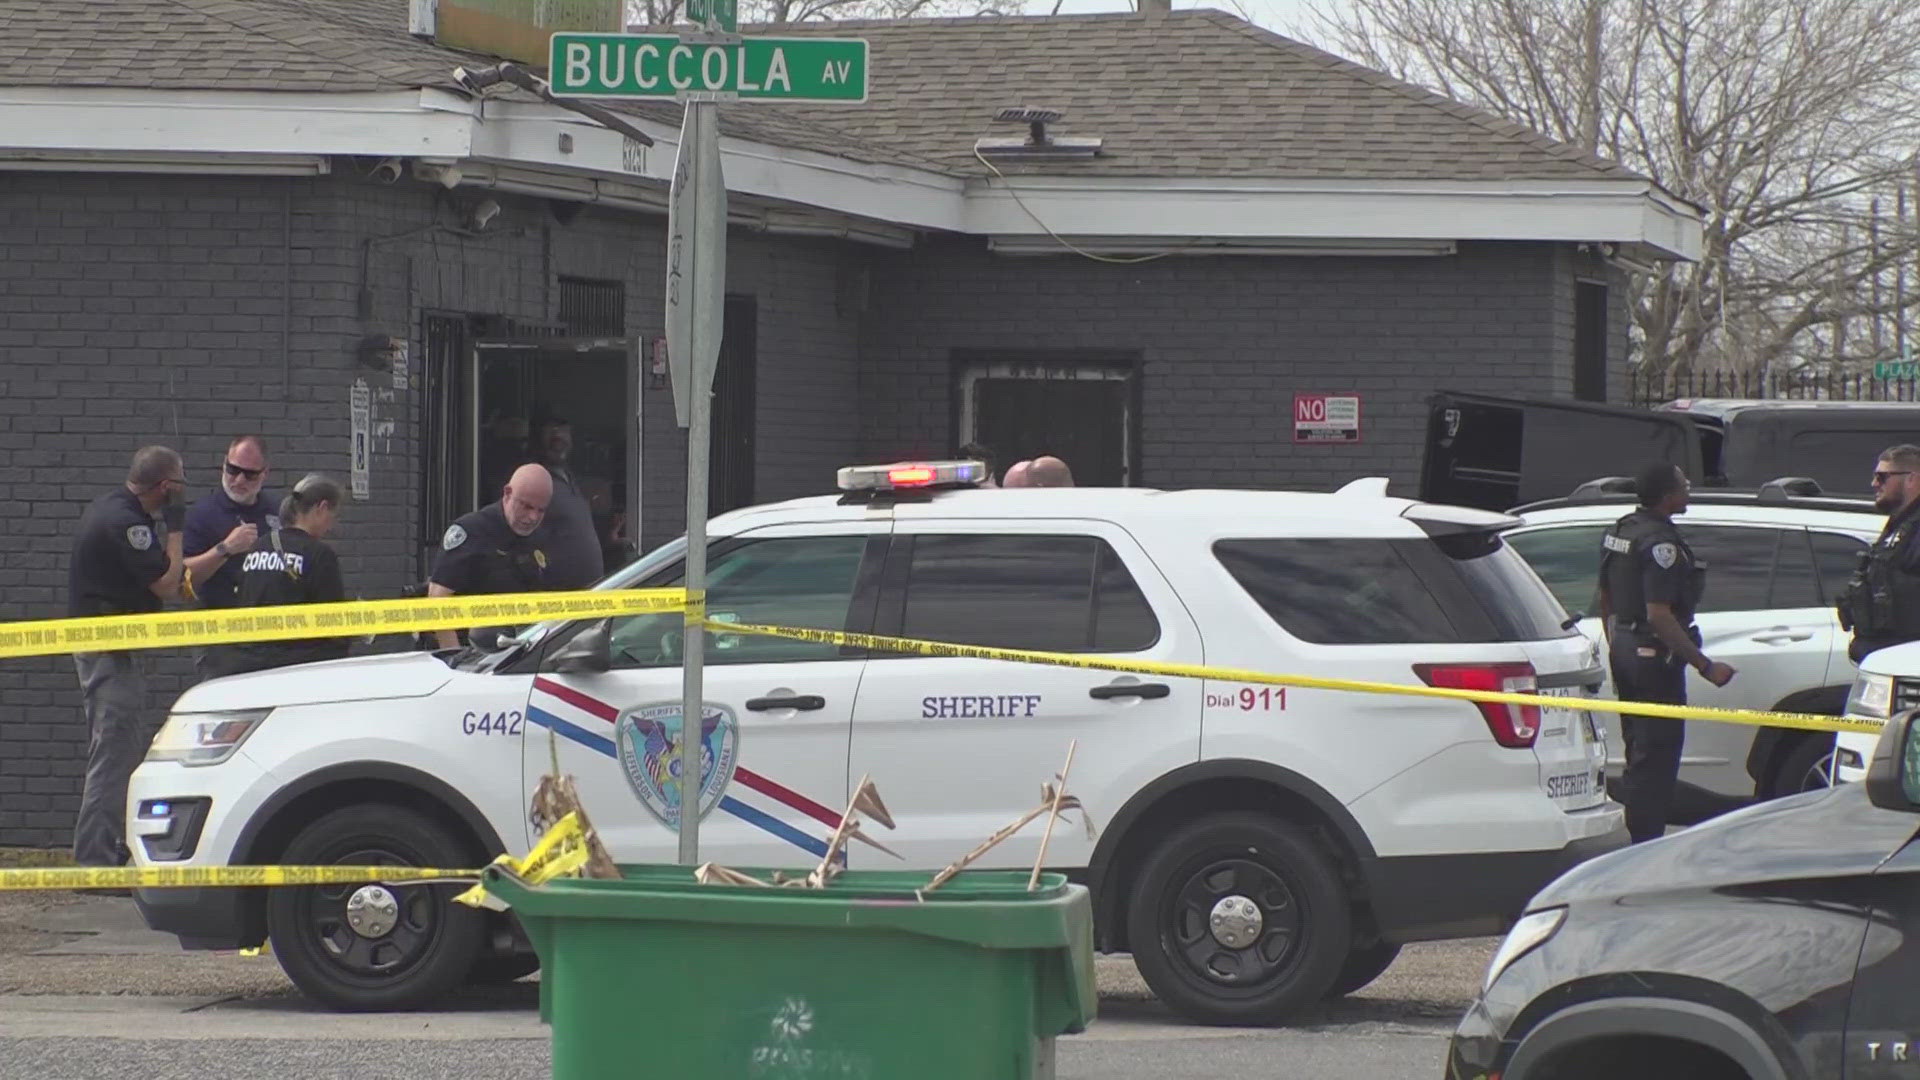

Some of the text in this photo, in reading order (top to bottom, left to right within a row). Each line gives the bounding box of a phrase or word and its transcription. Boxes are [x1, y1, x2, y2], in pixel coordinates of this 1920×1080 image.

[565, 43, 851, 91] BUCCOLA AV
[1299, 400, 1324, 420] NO
[922, 695, 1041, 718] SHERIFF
[1206, 687, 1286, 711] Dial 911
[463, 711, 522, 735] G442
[1547, 772, 1589, 798] SHERIFF
